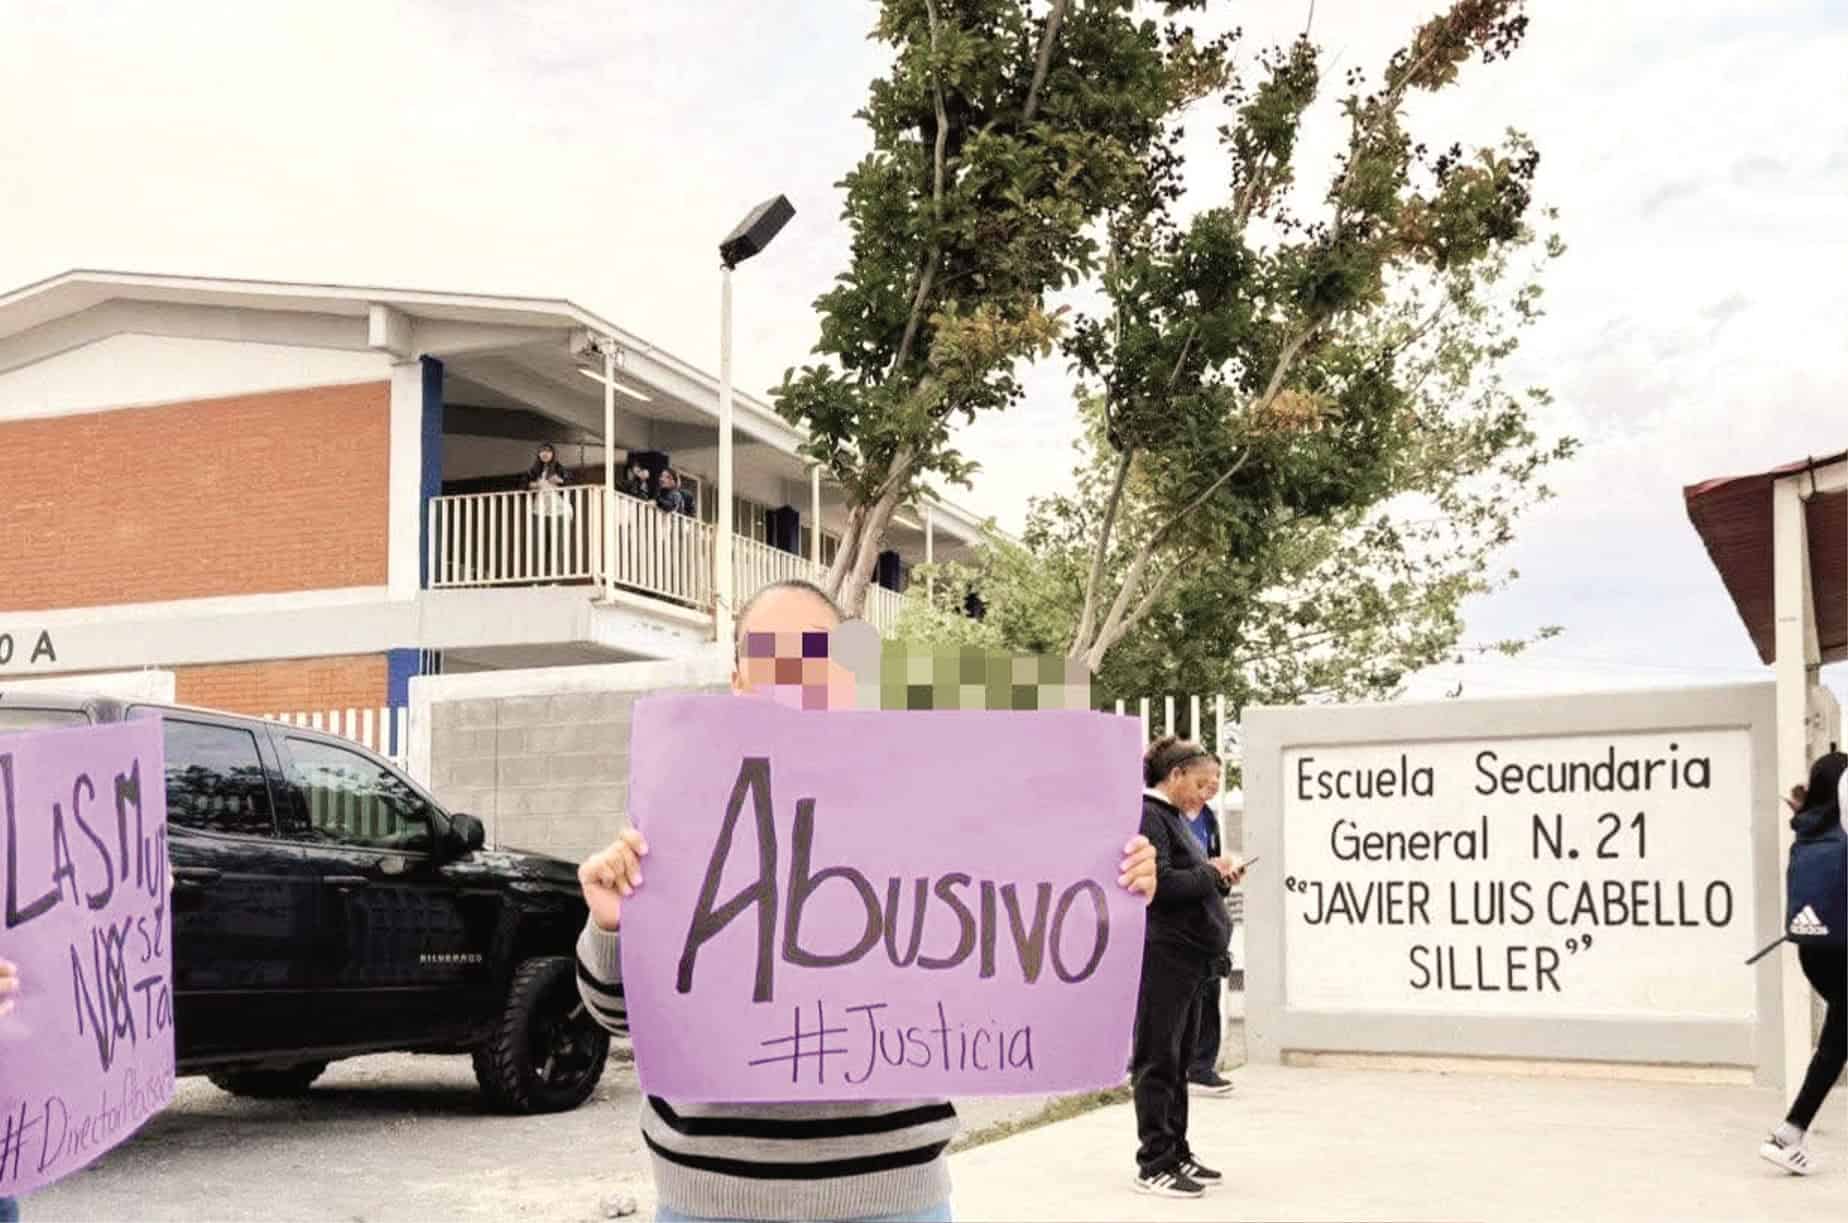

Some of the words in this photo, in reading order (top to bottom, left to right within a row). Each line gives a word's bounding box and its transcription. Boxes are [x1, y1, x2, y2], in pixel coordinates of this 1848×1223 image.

[31, 630, 56, 664] A
[1298, 754, 1434, 801] Escuela
[1475, 743, 1711, 796] Secundaria
[1331, 815, 1488, 861] General
[1533, 813, 1580, 860] N.
[1596, 811, 1647, 860] 21
[1450, 881, 1534, 926] LUIS
[1547, 880, 1734, 928] CABELLO
[747, 1001, 1034, 1085] #Justicia
